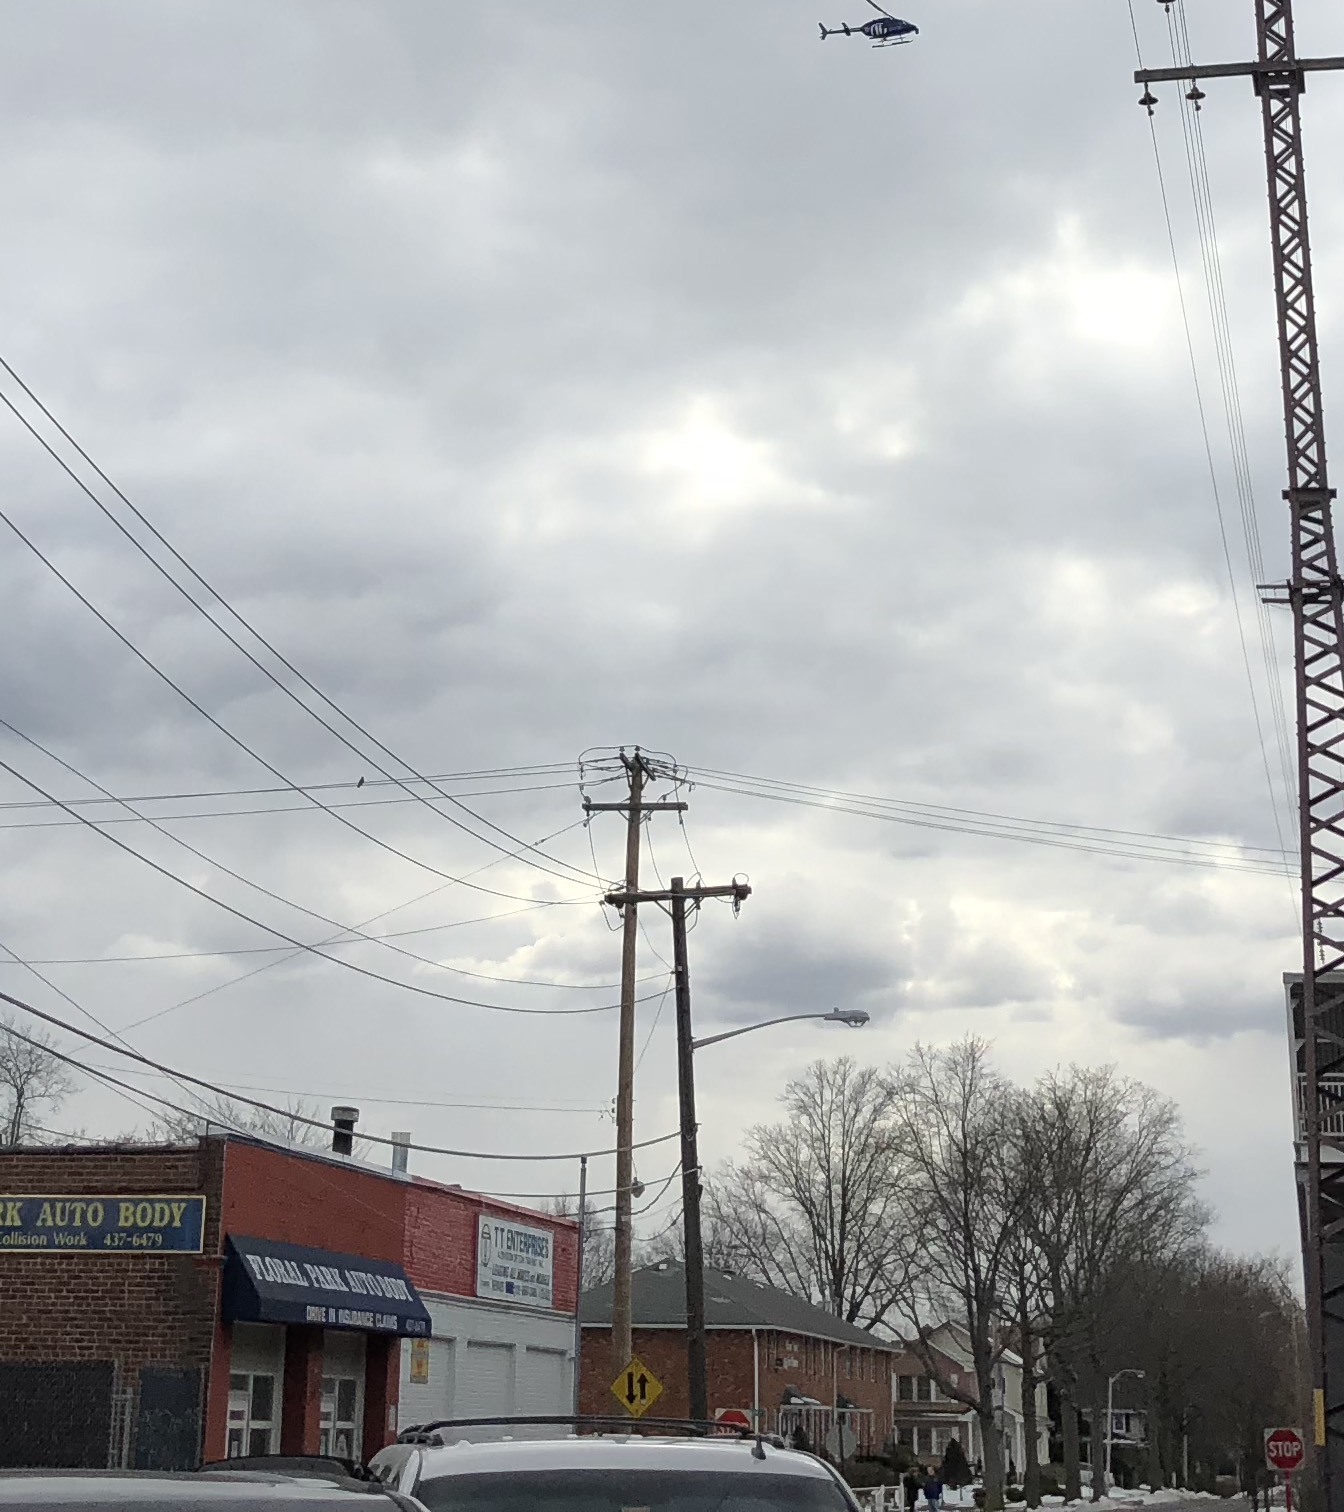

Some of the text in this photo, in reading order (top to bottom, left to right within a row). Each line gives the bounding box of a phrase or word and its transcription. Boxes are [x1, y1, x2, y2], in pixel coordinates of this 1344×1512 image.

[36, 1202, 104, 1227] AUTO
[119, 1202, 187, 1227] BODY
[53, 1232, 88, 1246] Work
[103, 1232, 163, 1247] 437-6479
[507, 1228, 549, 1259] ENTERPRISES
[245, 1254, 414, 1302] FLORAL PARK AUTO BODY
[306, 1305, 326, 1322] DRIVE
[328, 1307, 336, 1323] IN
[338, 1309, 374, 1327] INSURANCE
[375, 1313, 398, 1330] CLAIMS
[1268, 1441, 1302, 1457] STOP
